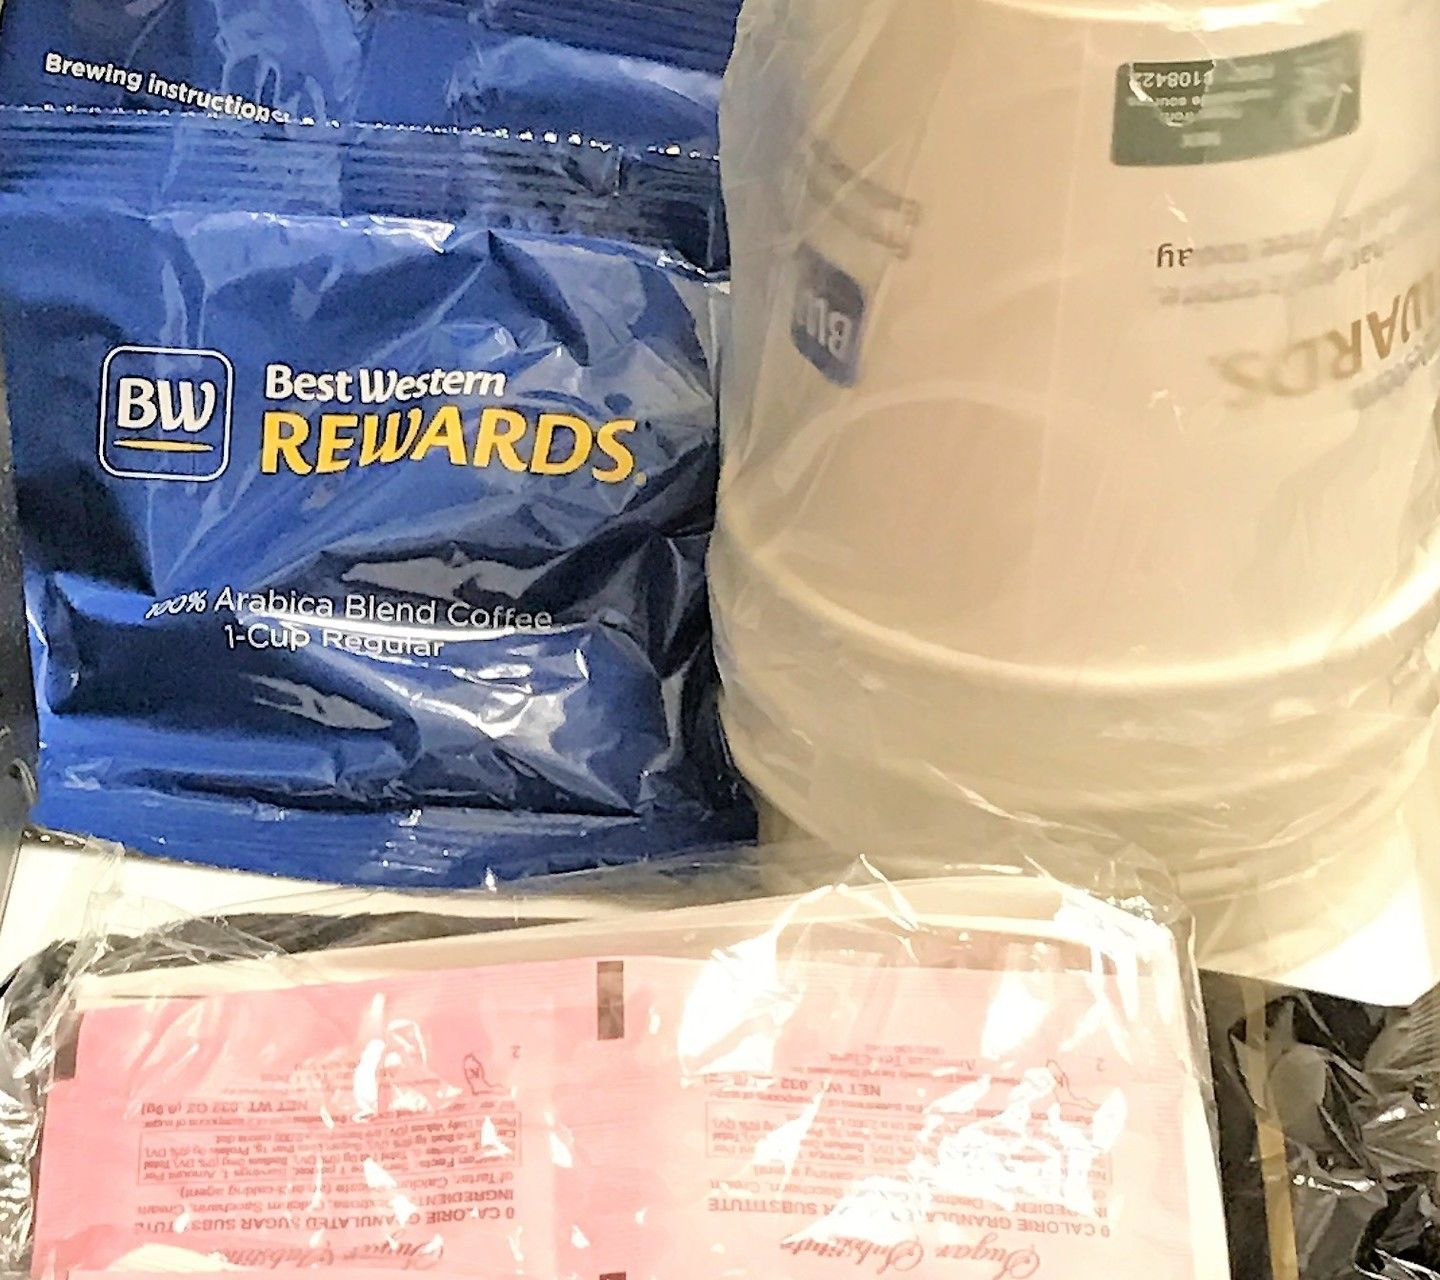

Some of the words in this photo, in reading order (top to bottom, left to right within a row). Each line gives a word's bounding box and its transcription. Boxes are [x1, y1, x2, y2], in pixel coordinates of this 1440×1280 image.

[44, 52, 144, 93] Brewing
[265, 363, 353, 403] Best
[356, 367, 508, 405] Western
[117, 376, 217, 434] BW
[261, 404, 638, 485] REWARDS
[145, 589, 208, 619] 100%
[213, 586, 334, 618] Arabica
[344, 594, 437, 625] Blend
[446, 601, 554, 629] Coffee
[224, 624, 312, 651] 1-Cup
[505, 1206, 516, 1220] 0
[708, 1198, 819, 1216] SUBSTITUTE
[1016, 1218, 1096, 1238] CALORIE
